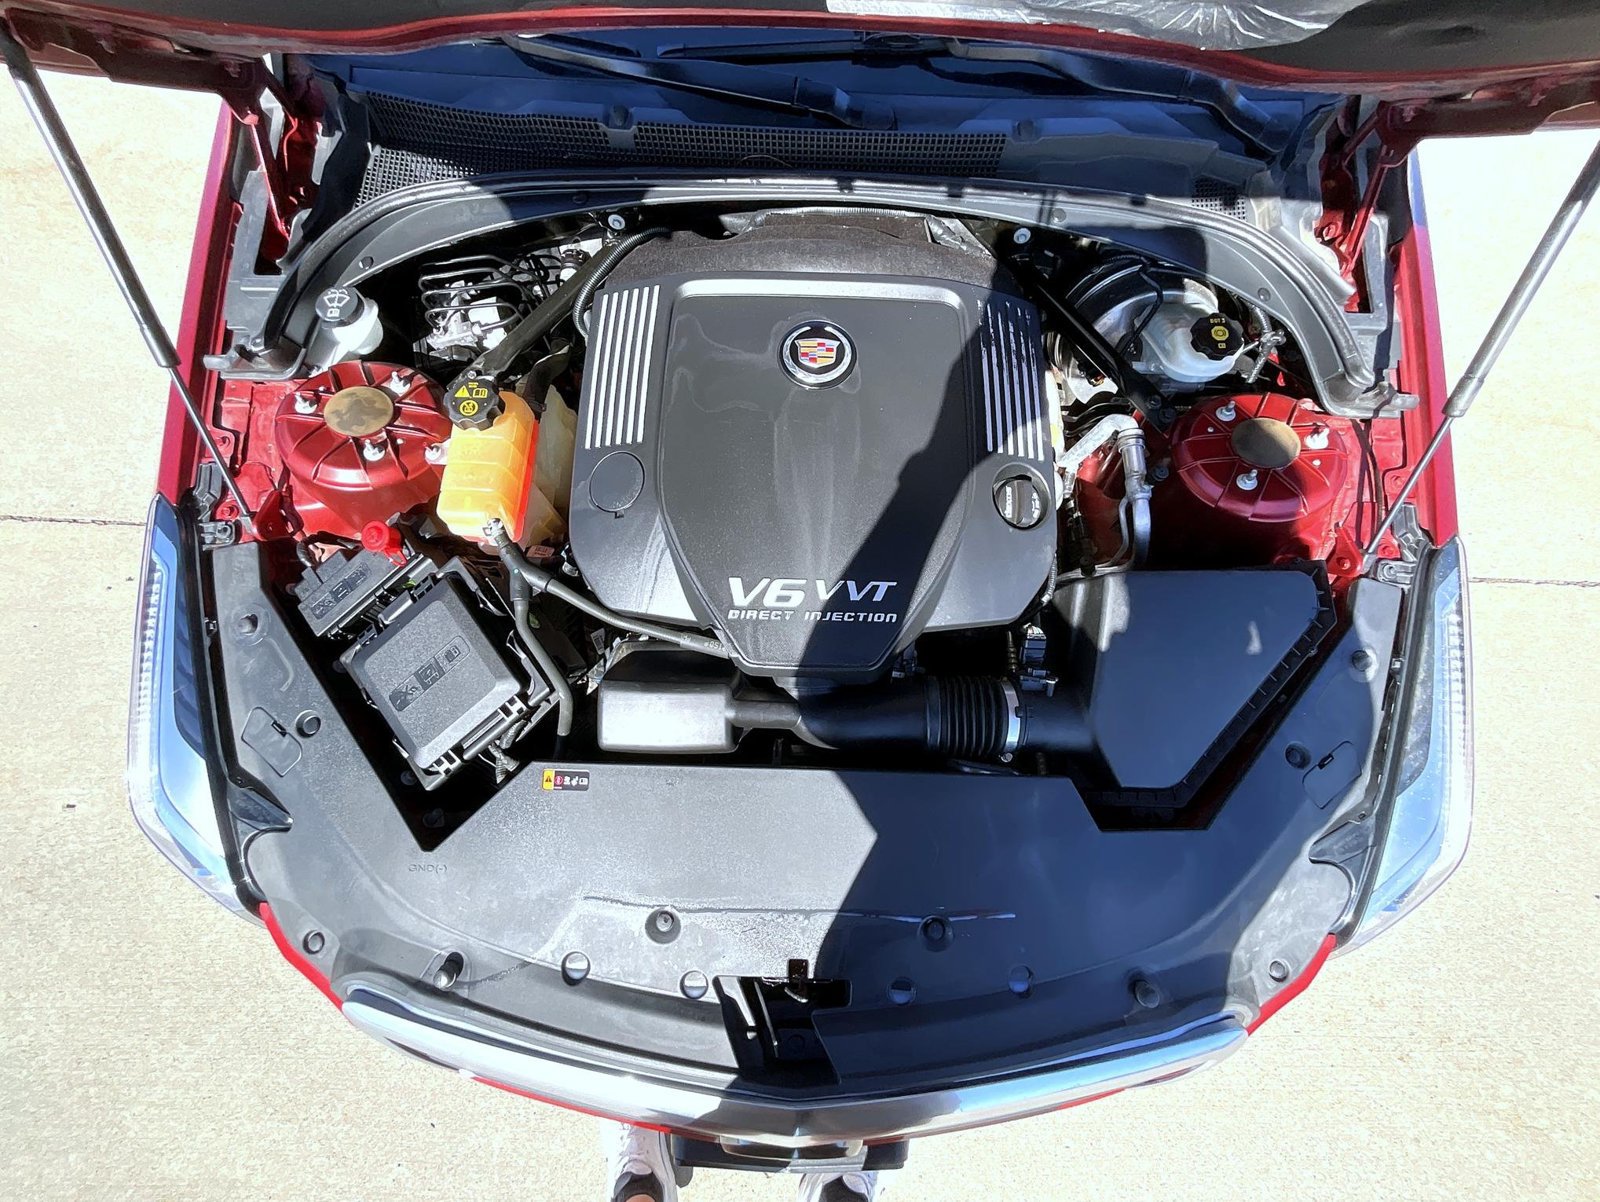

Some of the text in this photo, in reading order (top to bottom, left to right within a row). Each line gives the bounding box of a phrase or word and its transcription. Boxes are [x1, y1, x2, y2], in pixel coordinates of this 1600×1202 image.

[728, 577, 898, 608] V6 VVT
[727, 609, 898, 623] DIRECT INJECTION
